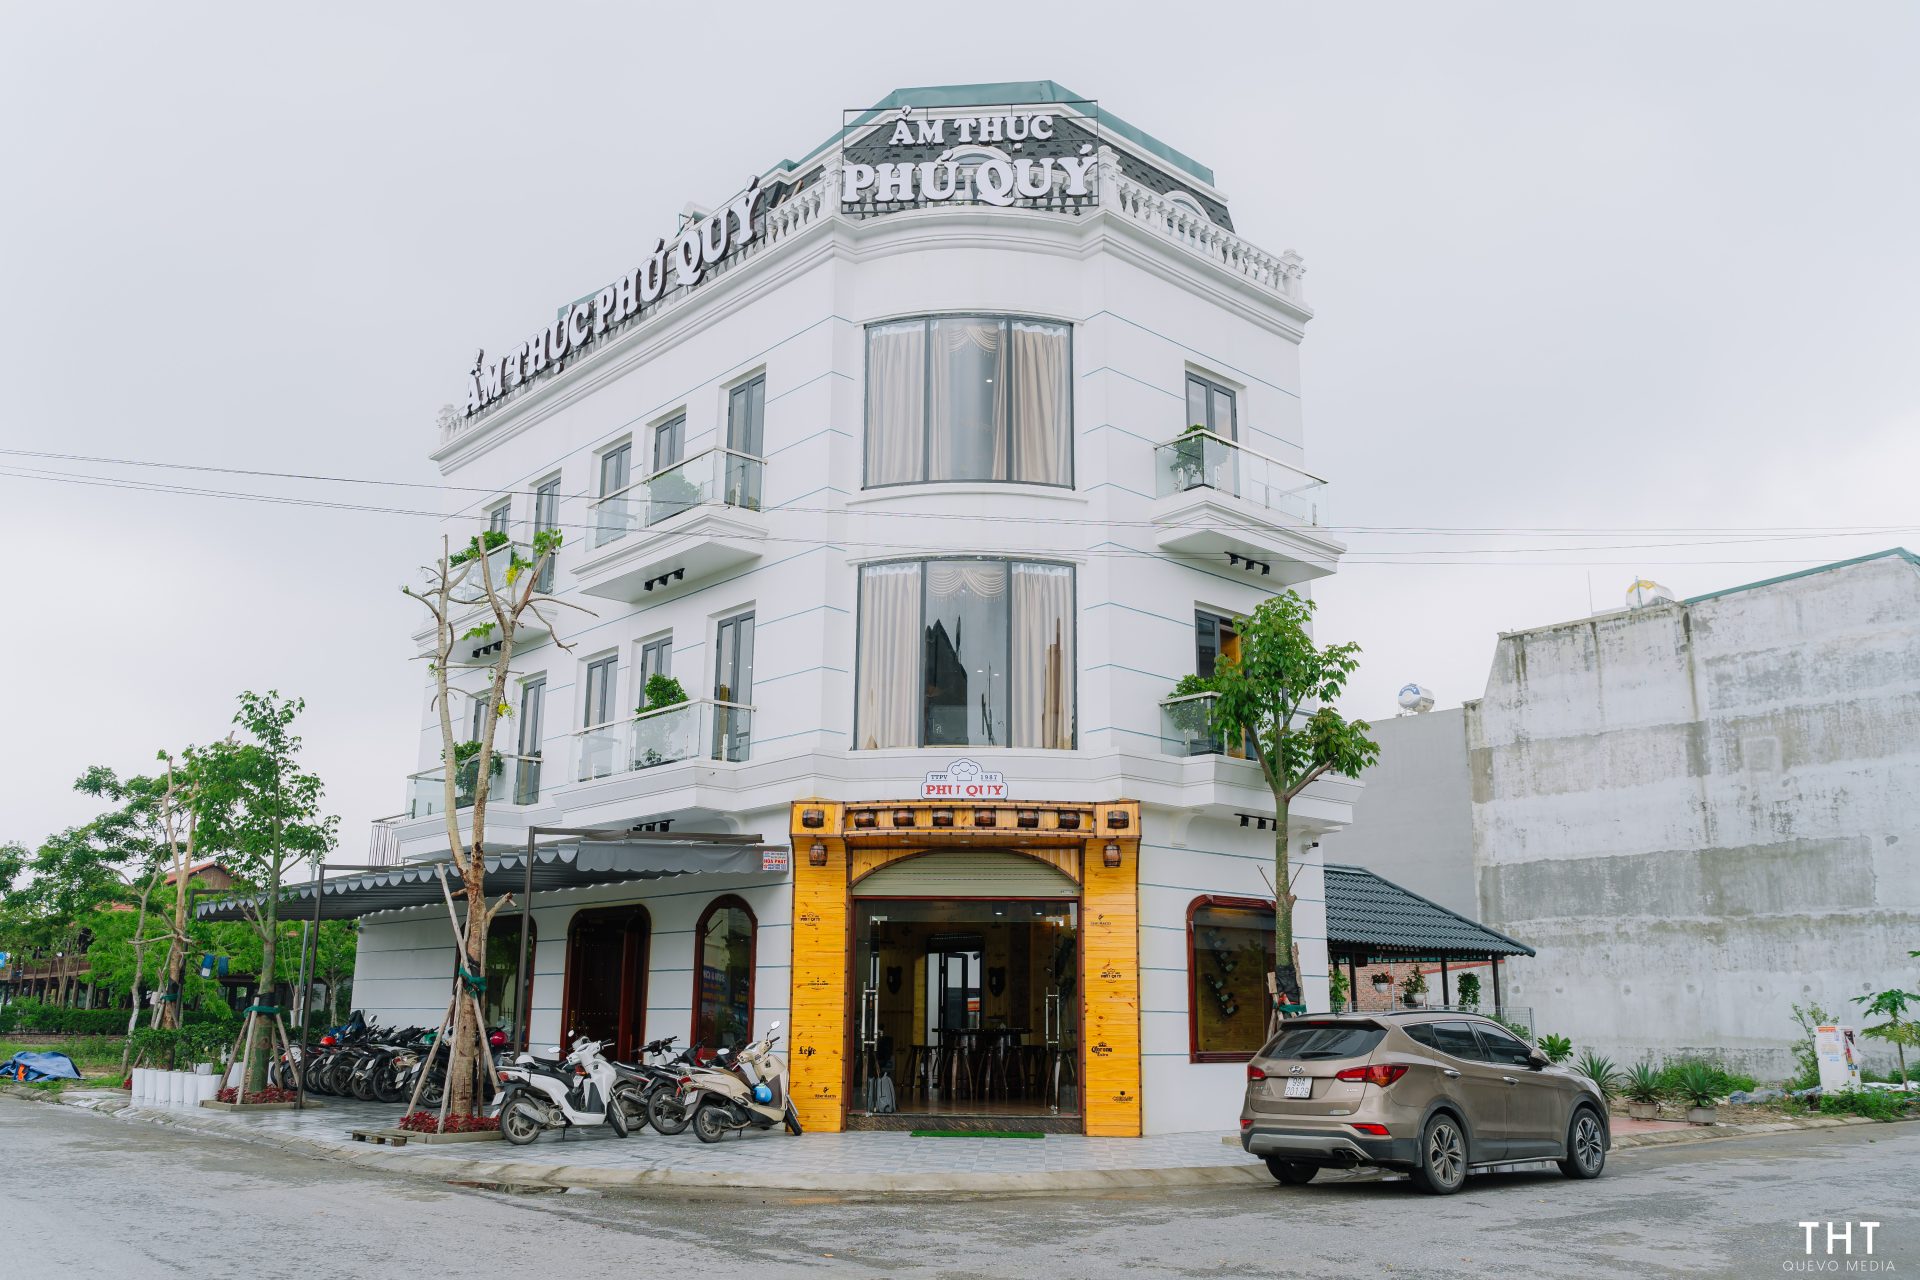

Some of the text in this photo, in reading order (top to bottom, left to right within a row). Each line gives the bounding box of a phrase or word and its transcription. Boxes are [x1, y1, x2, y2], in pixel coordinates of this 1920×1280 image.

[889, 105, 1053, 151] ẨM THỰC
[842, 144, 1098, 207] PHÚ QUÝ
[593, 237, 668, 334] PHÚ
[676, 175, 767, 286] QUÝ
